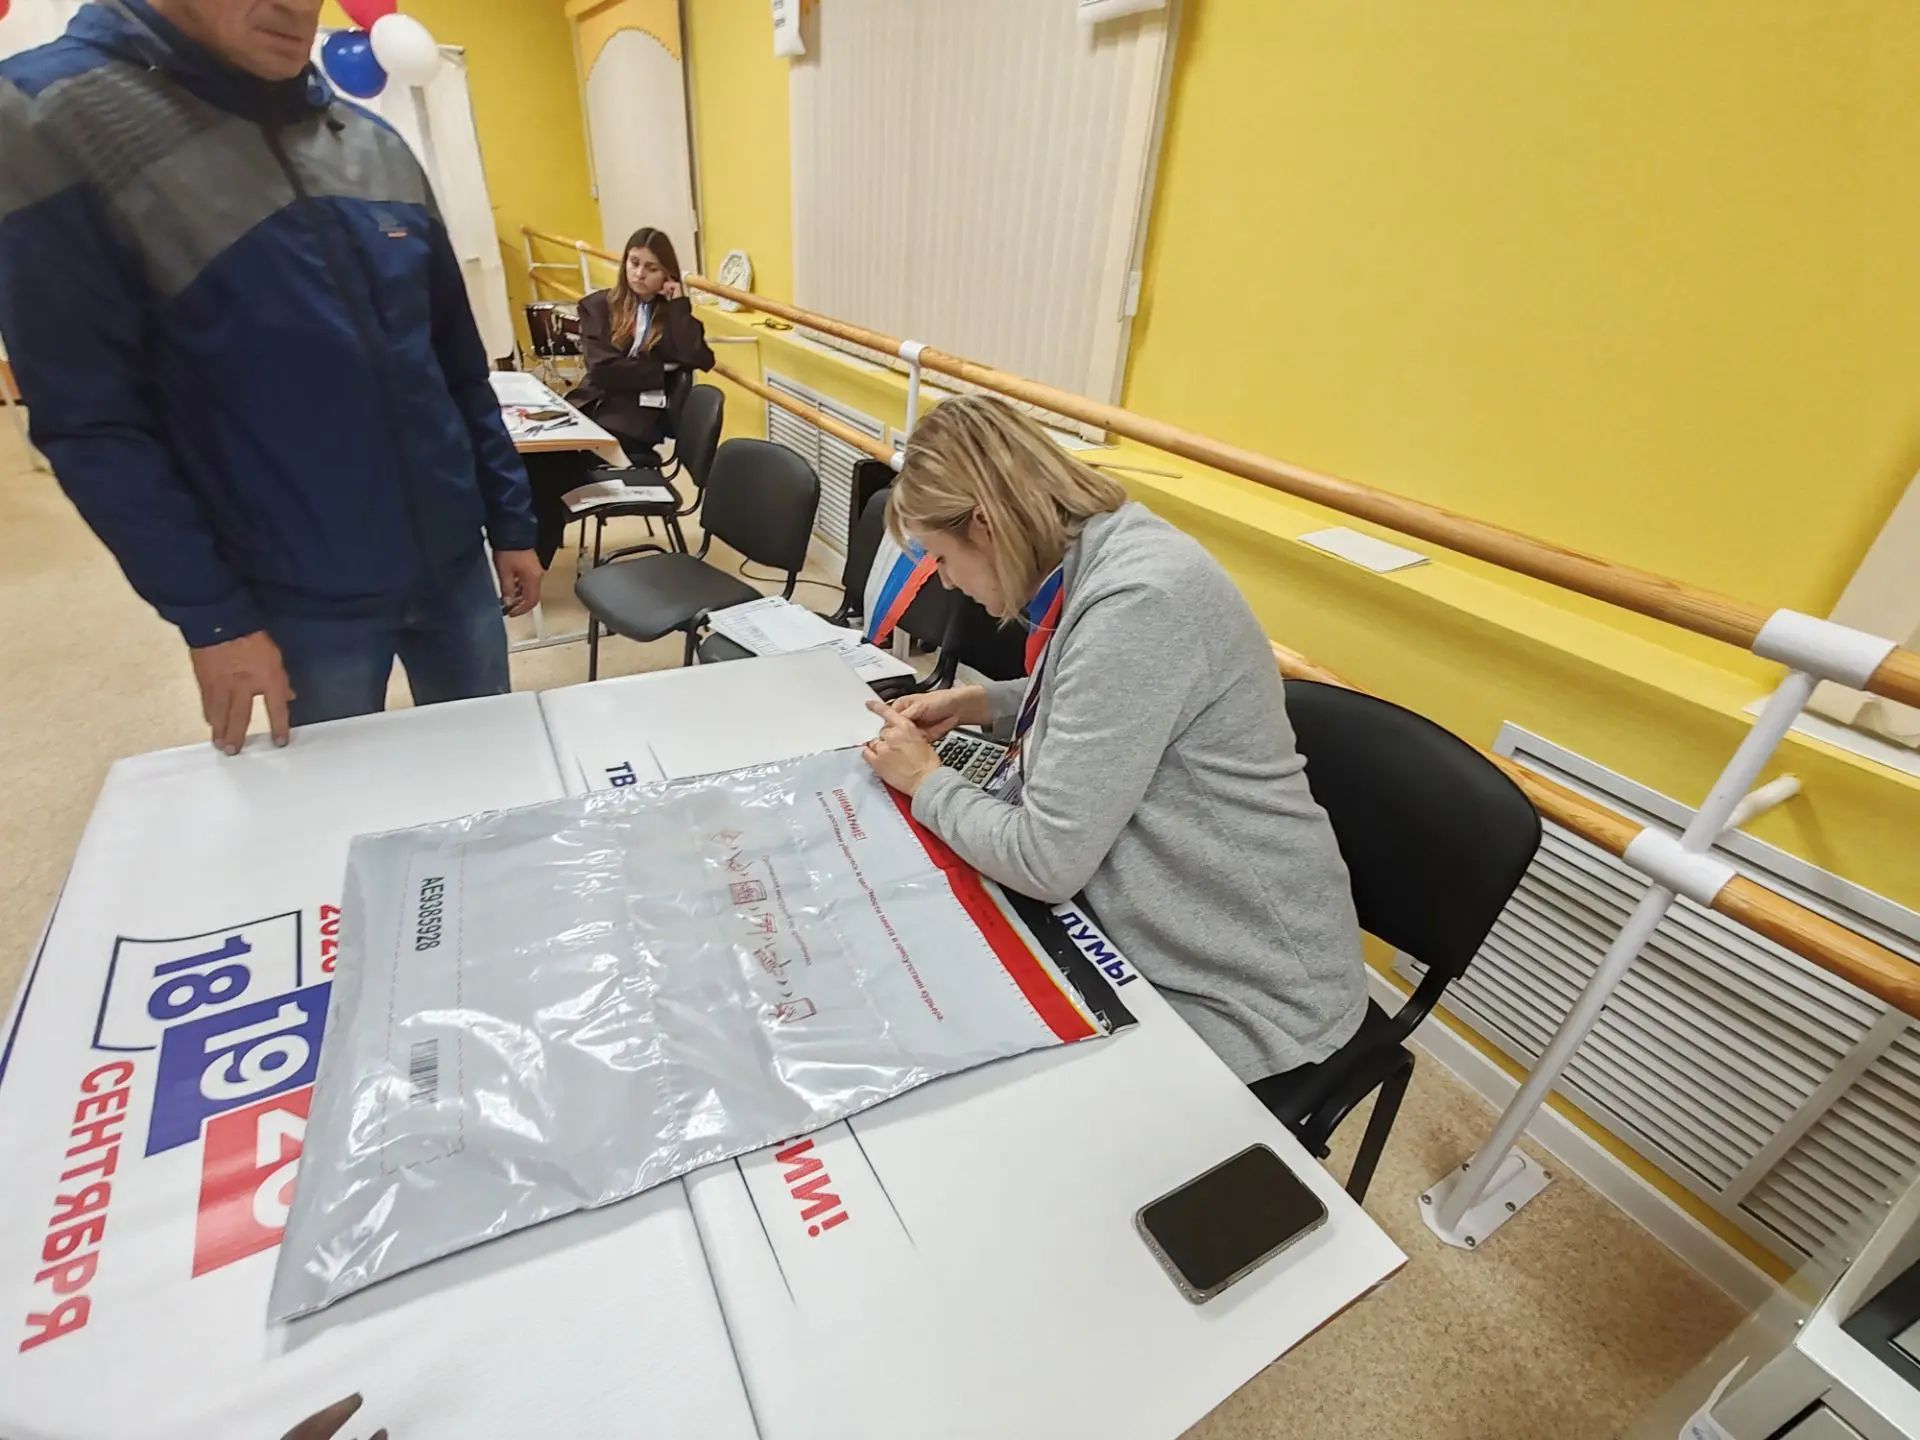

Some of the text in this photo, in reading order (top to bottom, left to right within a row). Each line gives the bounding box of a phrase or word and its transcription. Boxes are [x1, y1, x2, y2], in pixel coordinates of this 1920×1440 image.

[832, 788, 867, 841] ВНИМАНИЕ!
[415, 876, 445, 951] AE9385928
[1055, 911, 1139, 987] ДУМЫ
[147, 935, 252, 1021] 18
[200, 1001, 310, 1100] 19
[19, 1060, 135, 1353] СЕНТЯБРЯ
[775, 1137, 849, 1238] ИИ!
